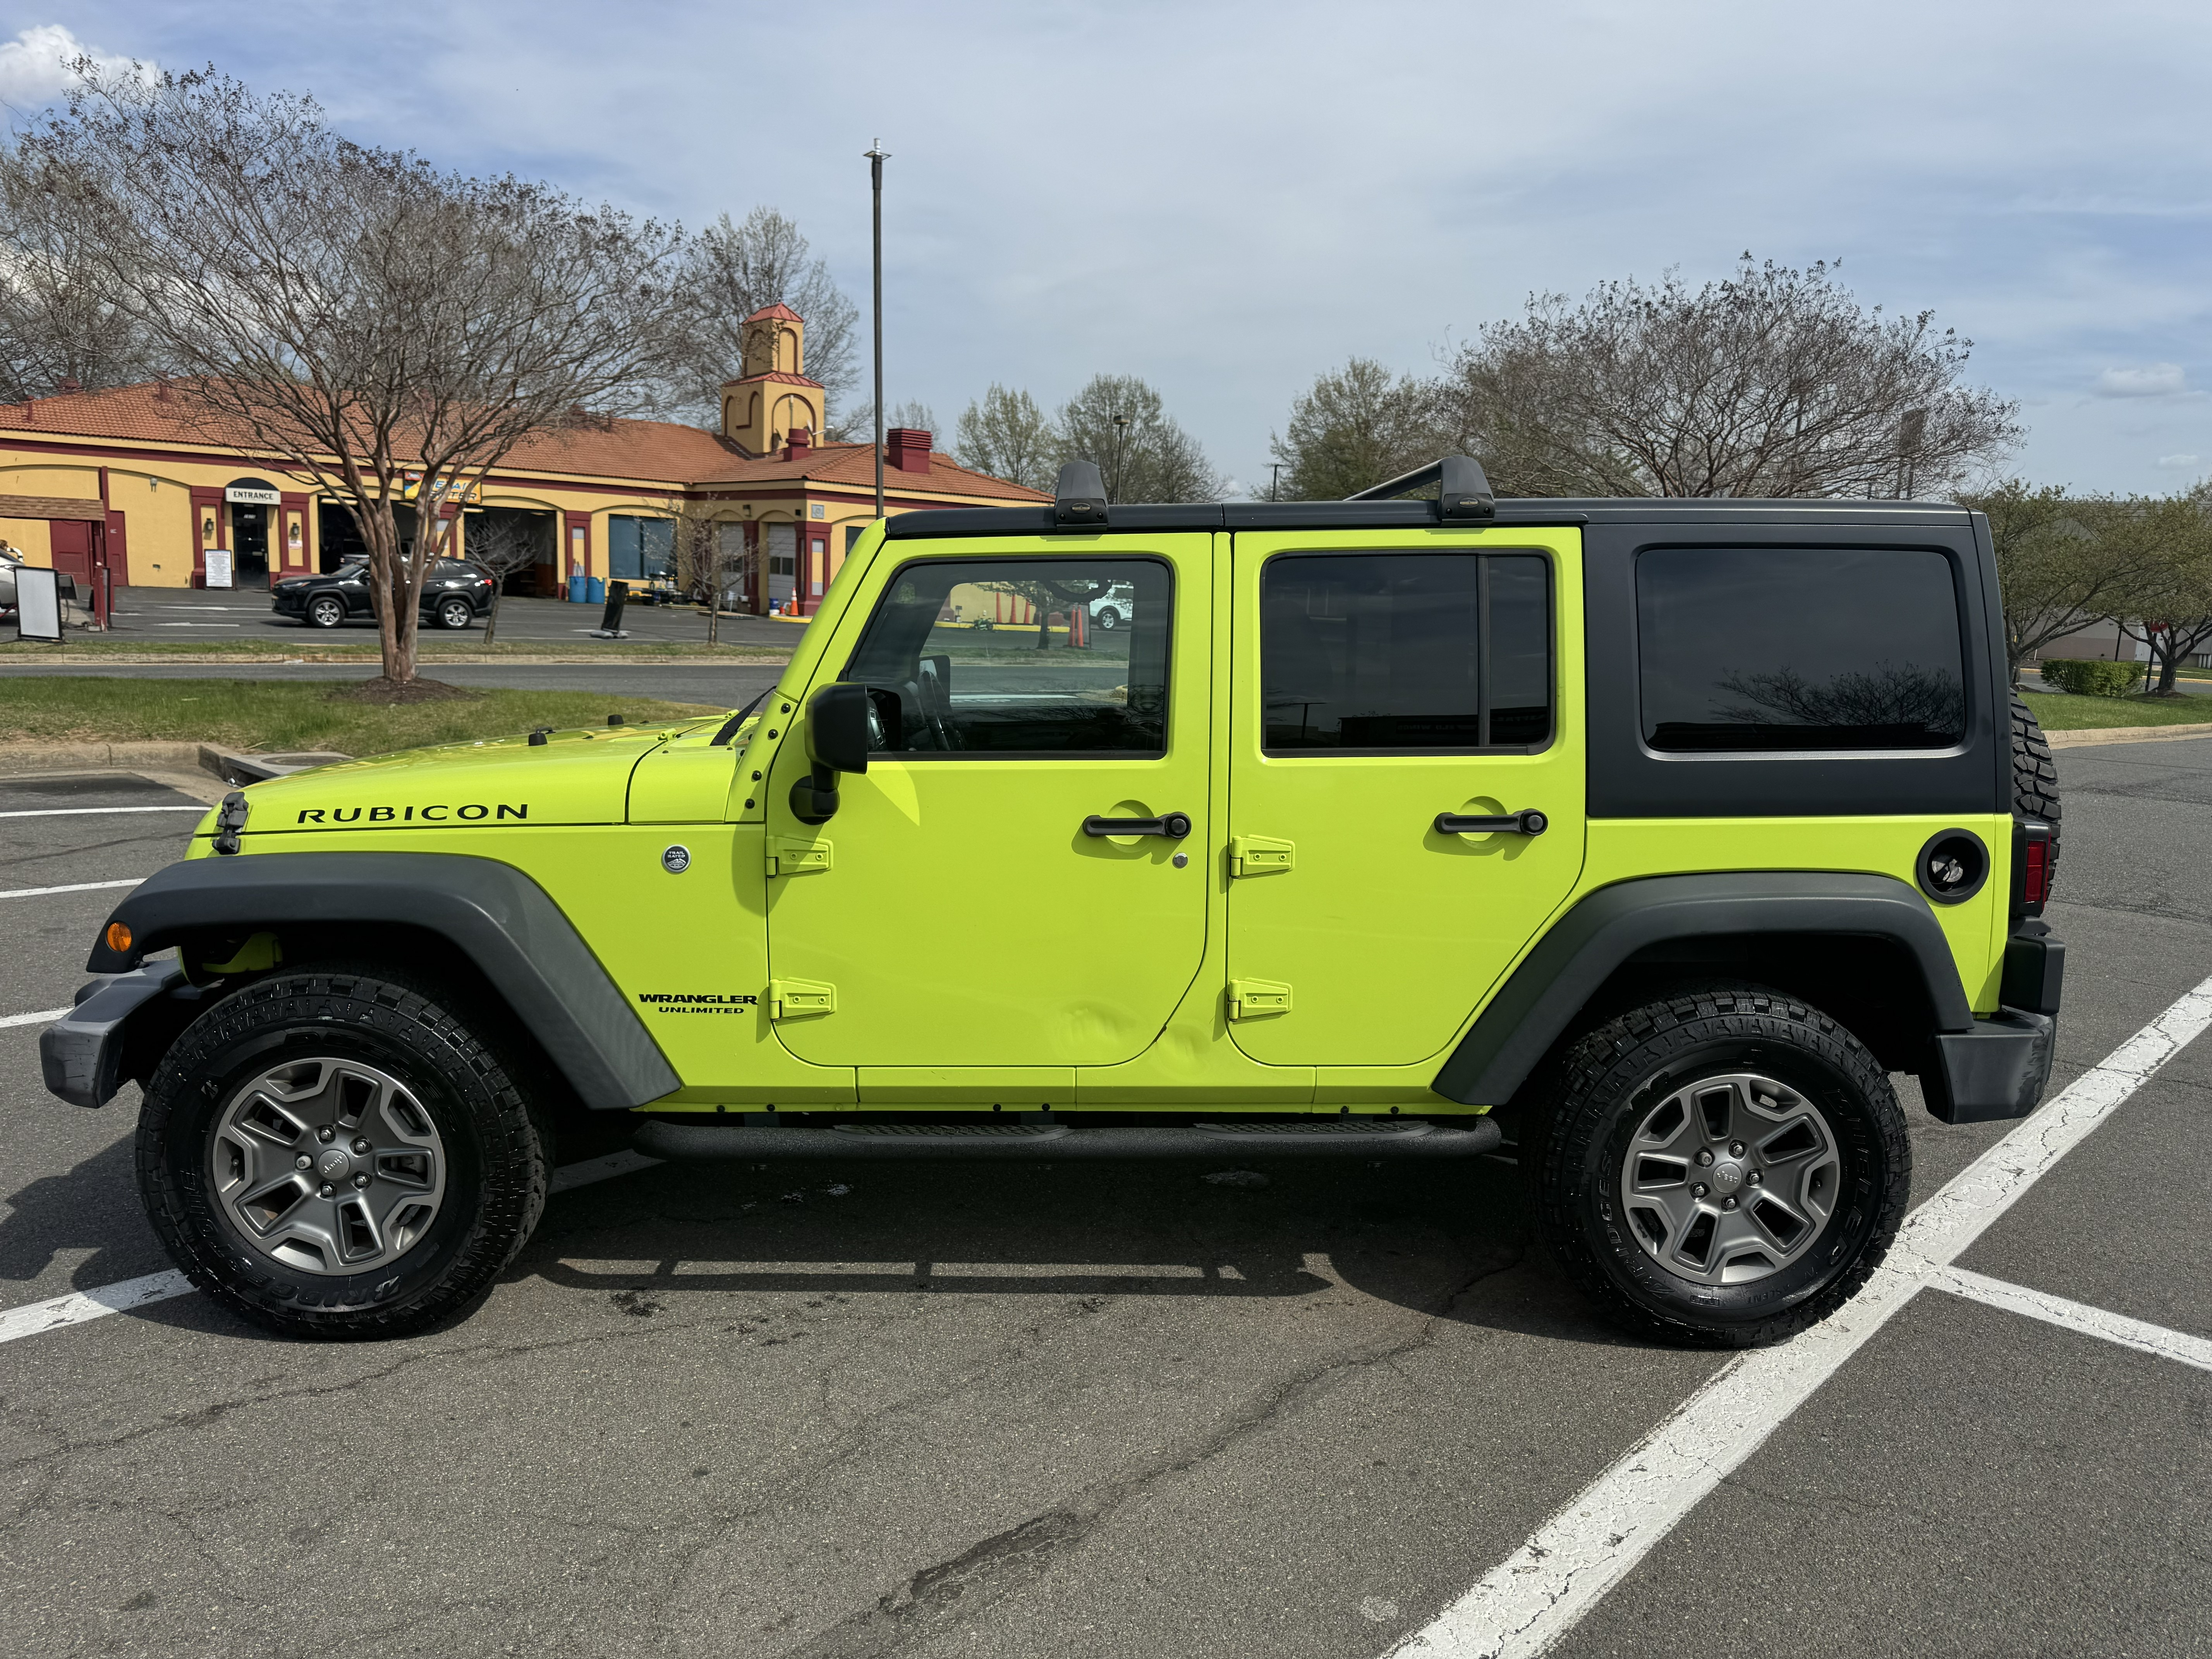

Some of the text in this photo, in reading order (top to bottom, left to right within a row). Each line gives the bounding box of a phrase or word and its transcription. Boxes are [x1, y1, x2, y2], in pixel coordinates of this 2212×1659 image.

[234, 491, 274, 500] ENTRANCE
[297, 804, 528, 824] RUBICON
[639, 994, 758, 1005] WRANGLER
